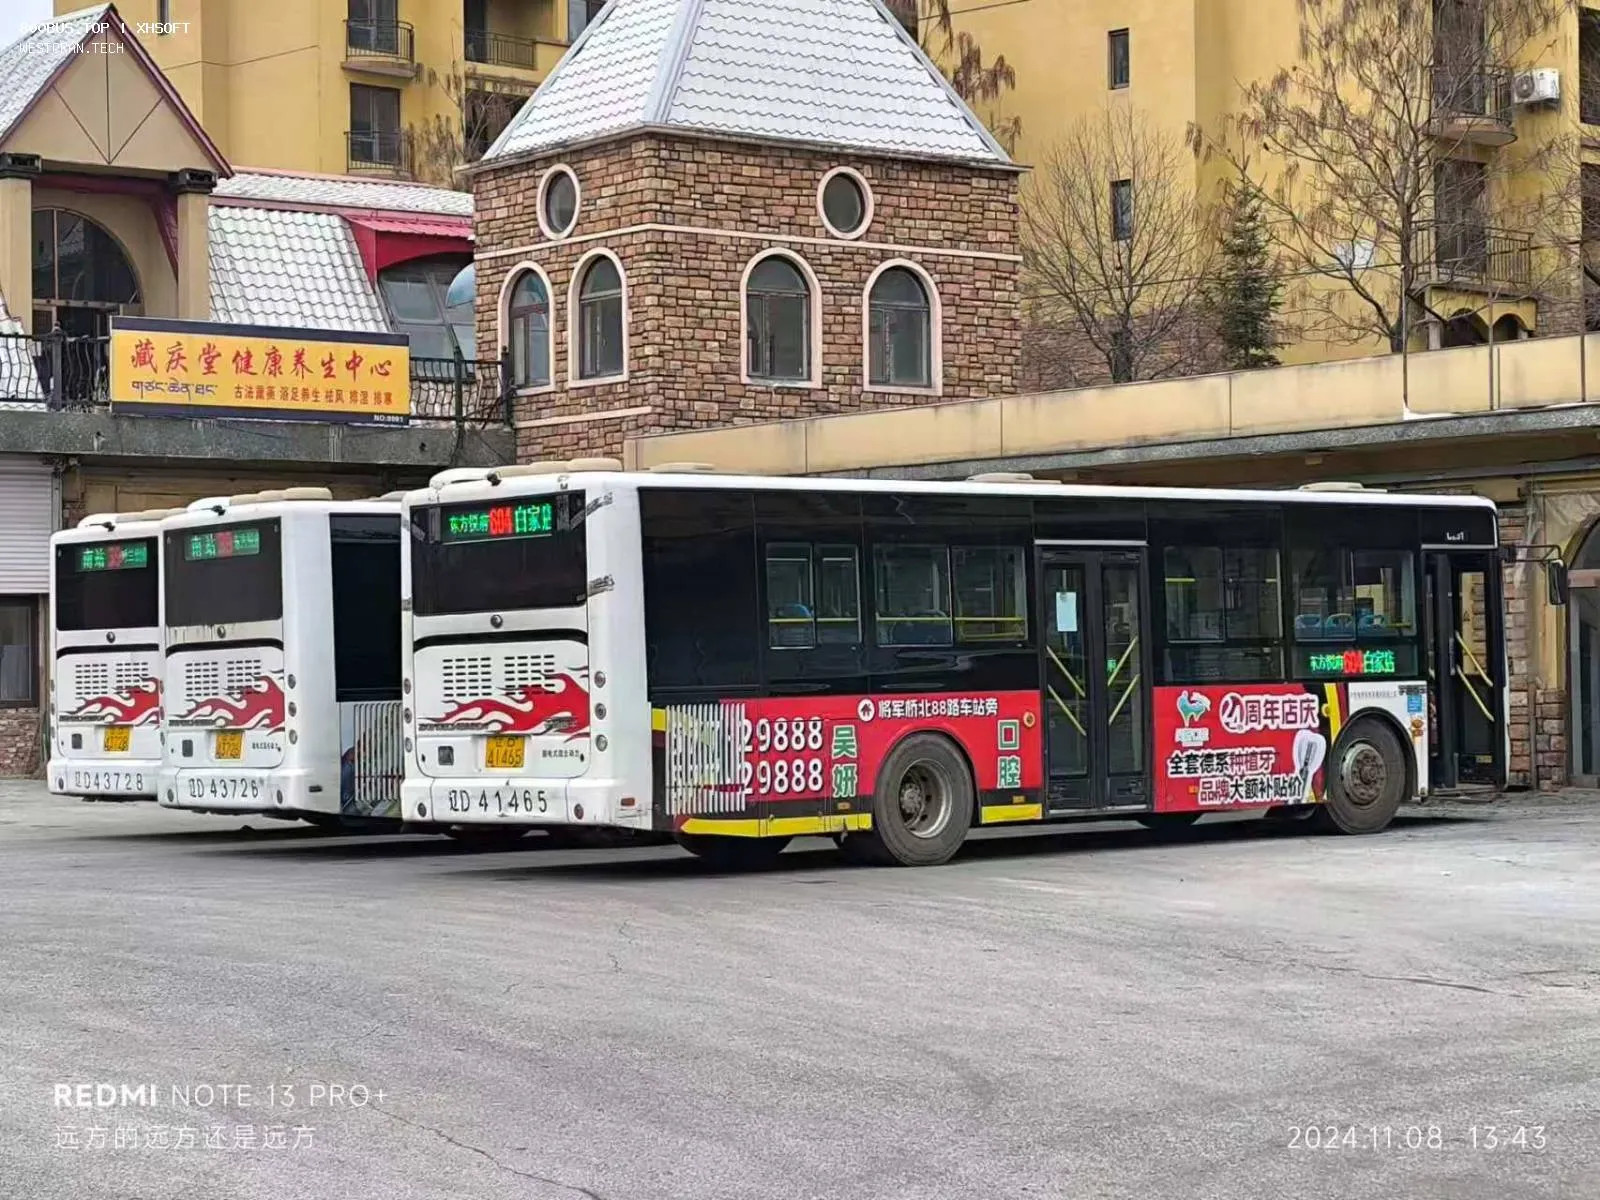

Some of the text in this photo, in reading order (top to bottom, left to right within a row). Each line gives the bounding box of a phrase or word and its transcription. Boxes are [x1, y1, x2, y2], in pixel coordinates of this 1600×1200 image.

[131, 339, 393, 382] 藏庆堂健康养生中心
[878, 698, 998, 718] 将军桥北88路车站旁
[832, 725, 859, 798] 吴妍
[1169, 749, 1276, 776] 全套德系种植牙
